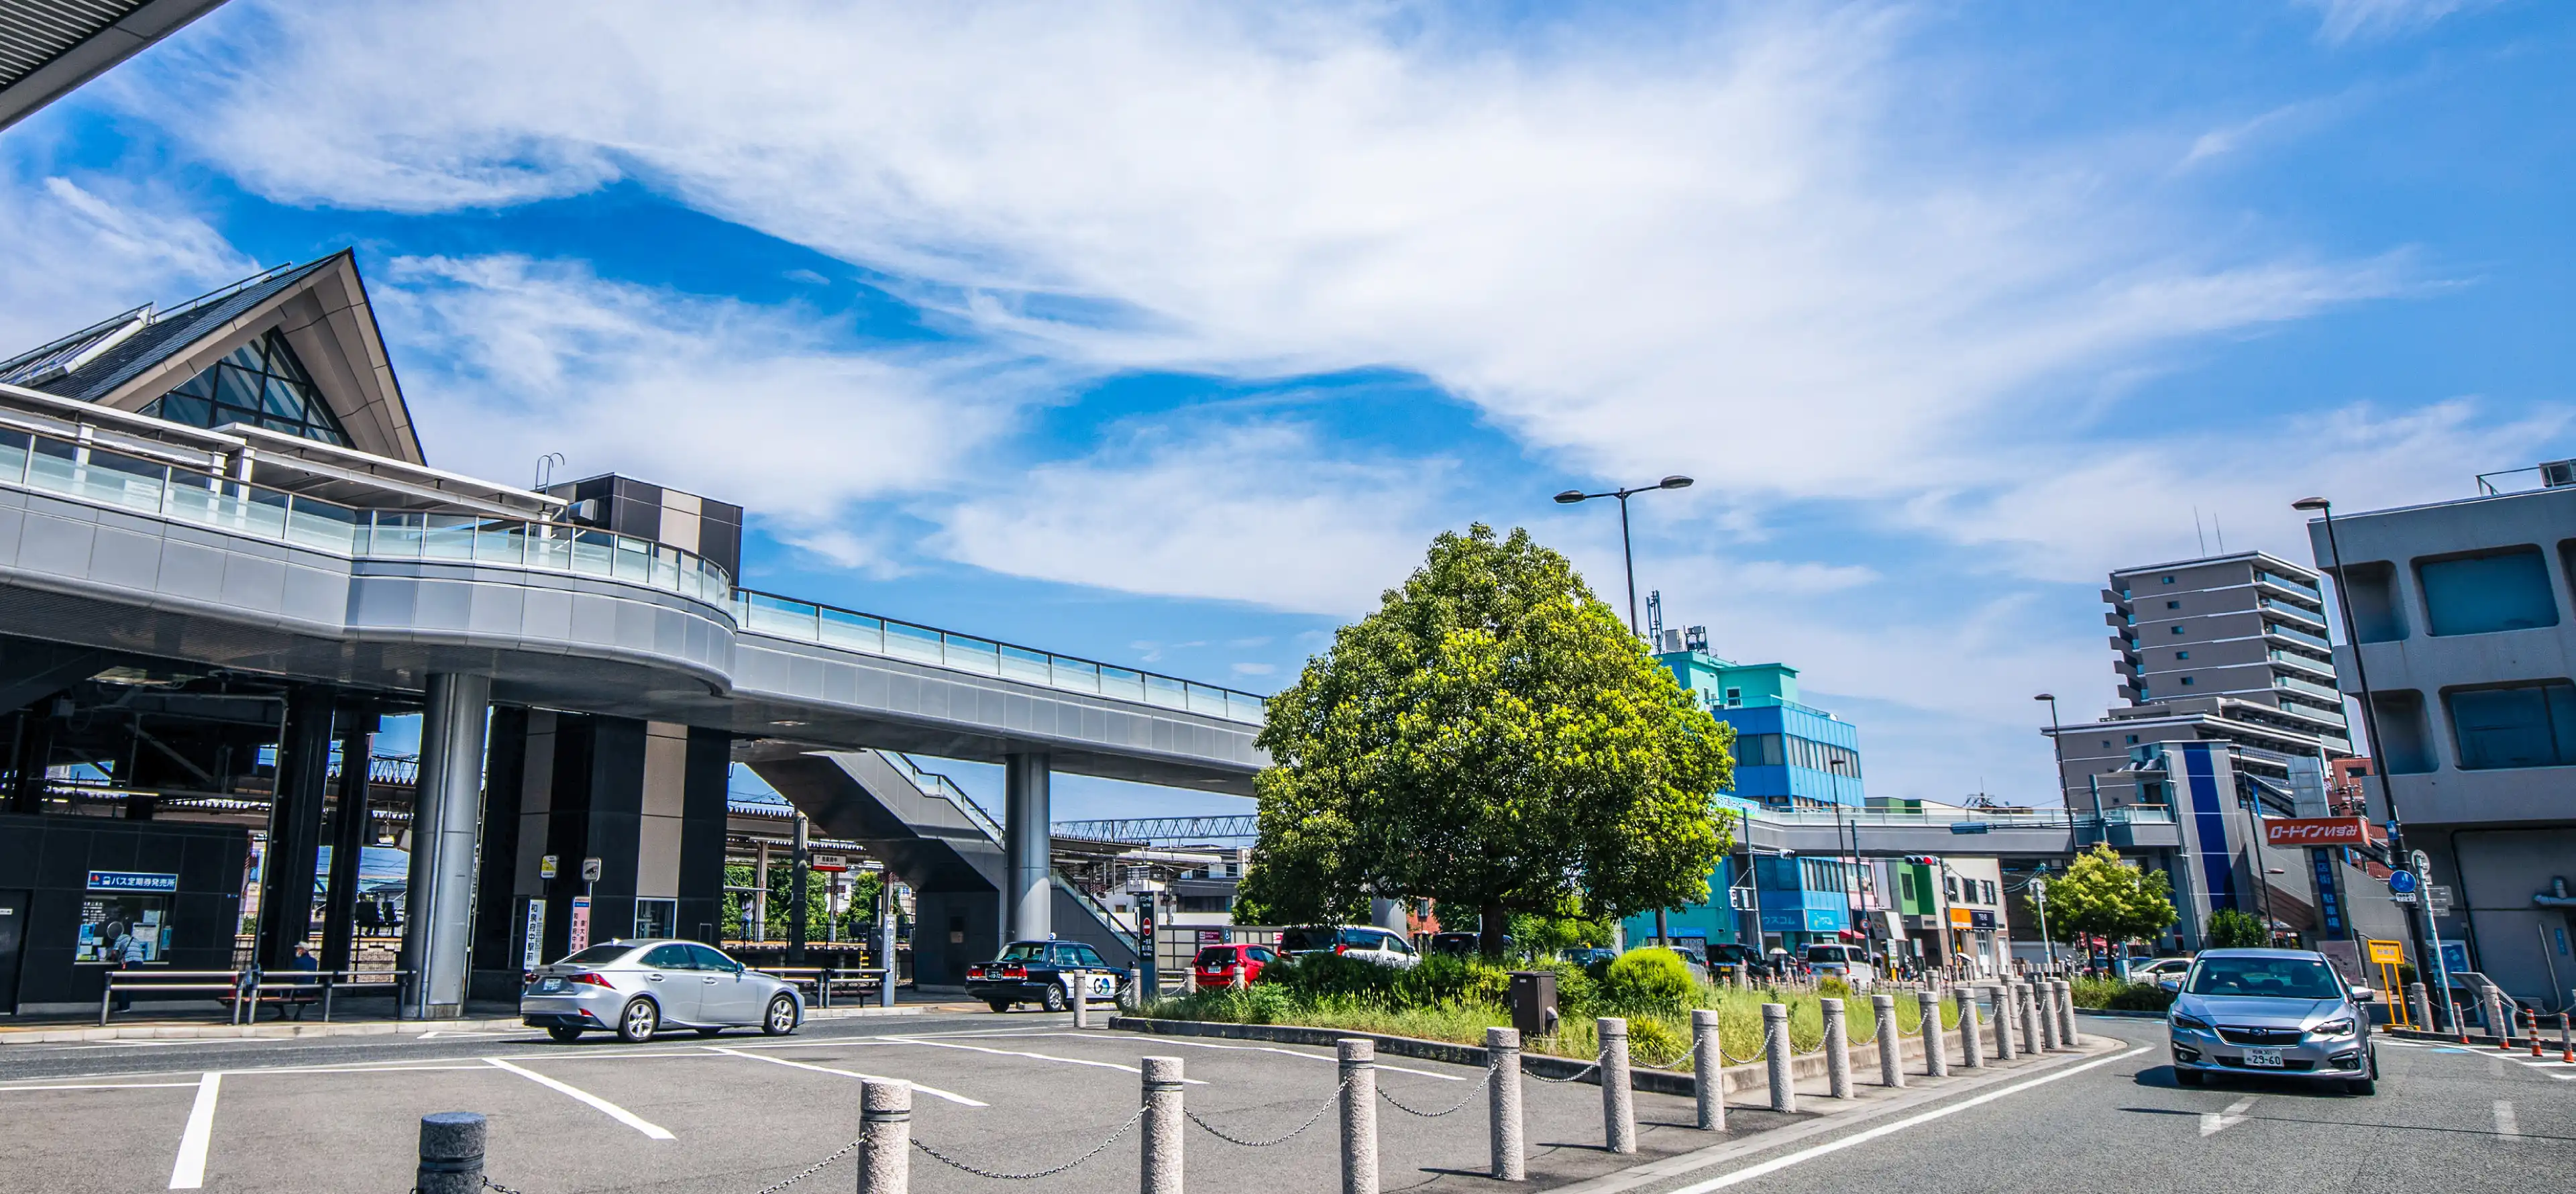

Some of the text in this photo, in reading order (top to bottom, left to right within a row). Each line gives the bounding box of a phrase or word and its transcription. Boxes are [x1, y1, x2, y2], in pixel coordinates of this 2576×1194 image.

[2269, 824, 2358, 838] ロードインいずみ
[1761, 916, 1796, 925] ウスコム
[527, 904, 538, 961] 和泉府中駅前
[1093, 978, 1110, 994] GO
[2252, 1055, 2281, 1065] 29-60
